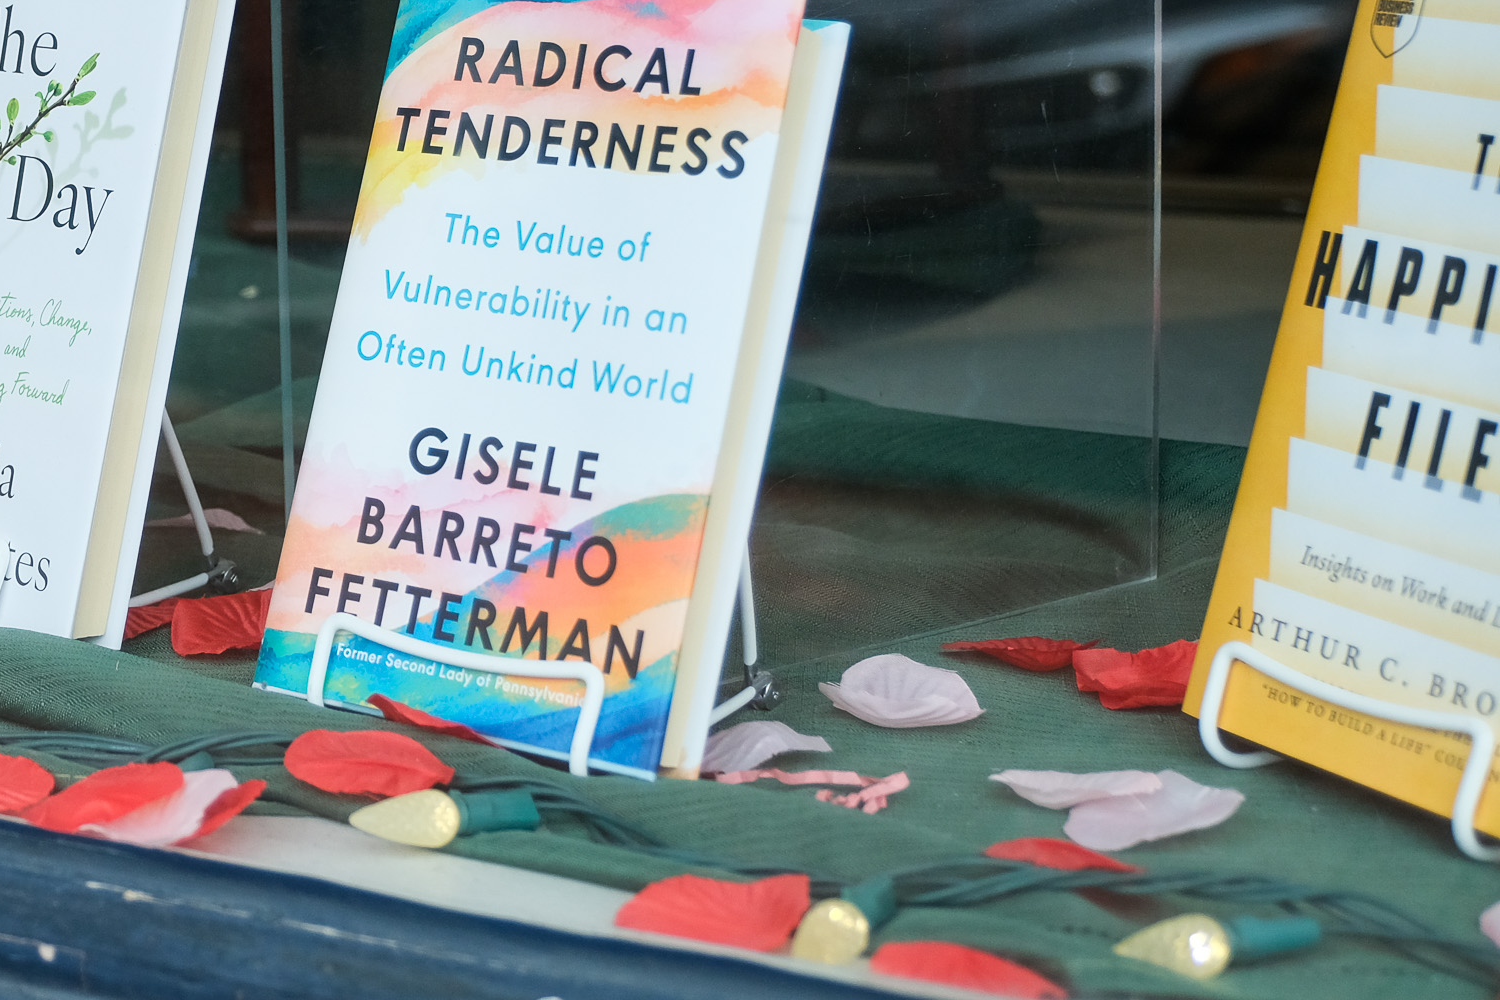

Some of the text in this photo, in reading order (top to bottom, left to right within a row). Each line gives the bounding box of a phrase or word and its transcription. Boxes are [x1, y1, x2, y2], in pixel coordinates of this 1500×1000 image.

[1373, 12, 1403, 28] REVIEW
[1377, 0, 1414, 15] BUSINESS
[453, 36, 702, 96] RADICAL
[396, 107, 749, 179] TENDERNESS
[6, 154, 114, 255] Day
[445, 213, 652, 262] The Value of
[385, 269, 687, 334] Vulnerability in an
[1304, 230, 1498, 345] HAPPI
[3, 335, 32, 358] and
[39, 299, 92, 347] Change,
[10, 371, 70, 406] Forward
[357, 330, 694, 404] Often Unkind World
[408, 427, 600, 501] GISELE
[356, 496, 618, 587] BARRETO
[1299, 545, 1368, 584] Insights
[1370, 574, 1395, 593] on
[1399, 574, 1449, 611] Work
[1450, 599, 1488, 623] and
[304, 566, 645, 680] FETTERMAN
[336, 642, 383, 665] Former
[385, 653, 436, 677] Second
[439, 666, 473, 688] Lady
[476, 673, 492, 689] of
[1227, 605, 1498, 717] ARTHUR C. BRO
[1305, 700, 1326, 718] TO
[1328, 710, 1374, 736] BUILD
[1376, 728, 1388, 741] A
